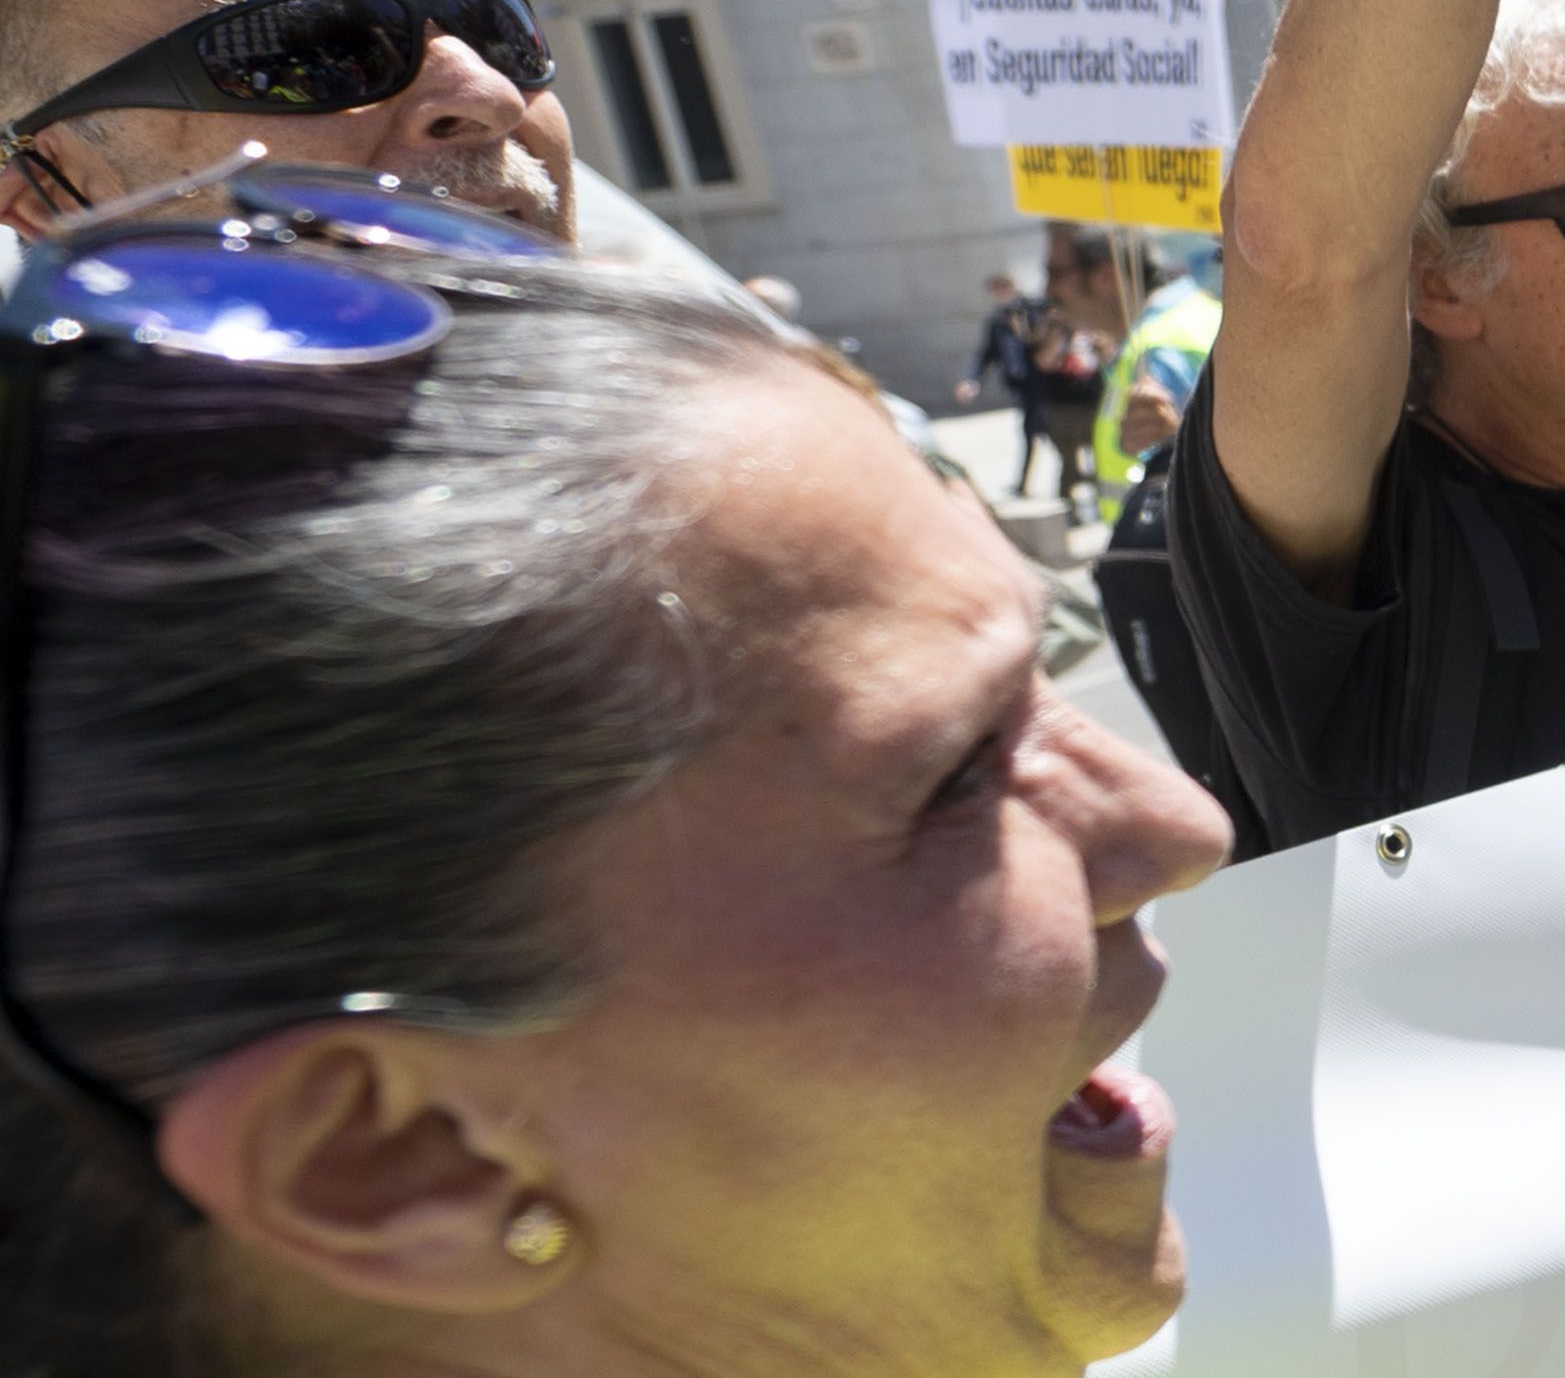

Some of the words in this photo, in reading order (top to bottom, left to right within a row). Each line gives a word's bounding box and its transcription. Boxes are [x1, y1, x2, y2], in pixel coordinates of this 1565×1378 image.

[948, 48, 977, 83] en
[984, 36, 1118, 96] Seguridad
[1120, 36, 1200, 85] Social!
